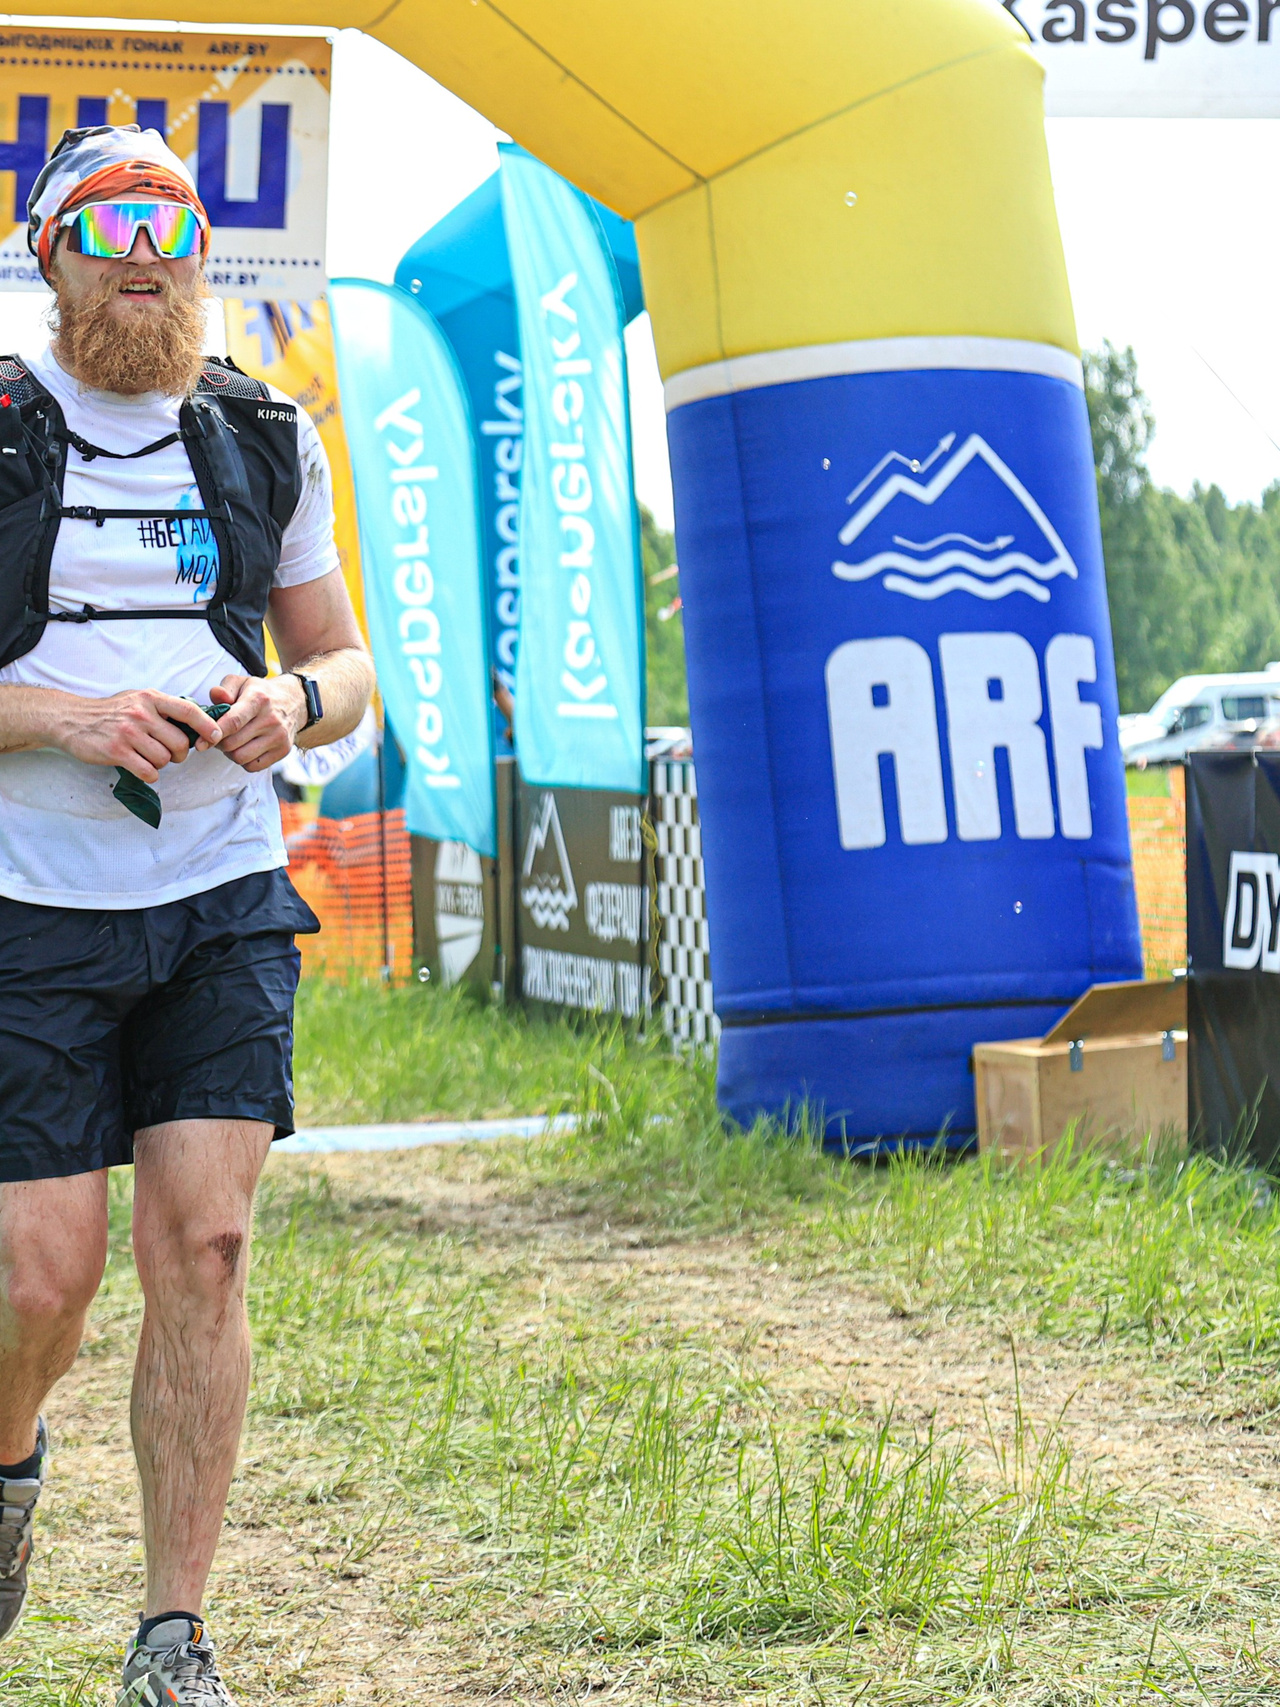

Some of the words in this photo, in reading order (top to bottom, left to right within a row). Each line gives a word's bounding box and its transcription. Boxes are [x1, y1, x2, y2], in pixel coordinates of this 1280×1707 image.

[121, 36, 185, 54] ГОНАК
[207, 39, 270, 57] ARF.BY
[825, 629, 1104, 852] ARF
